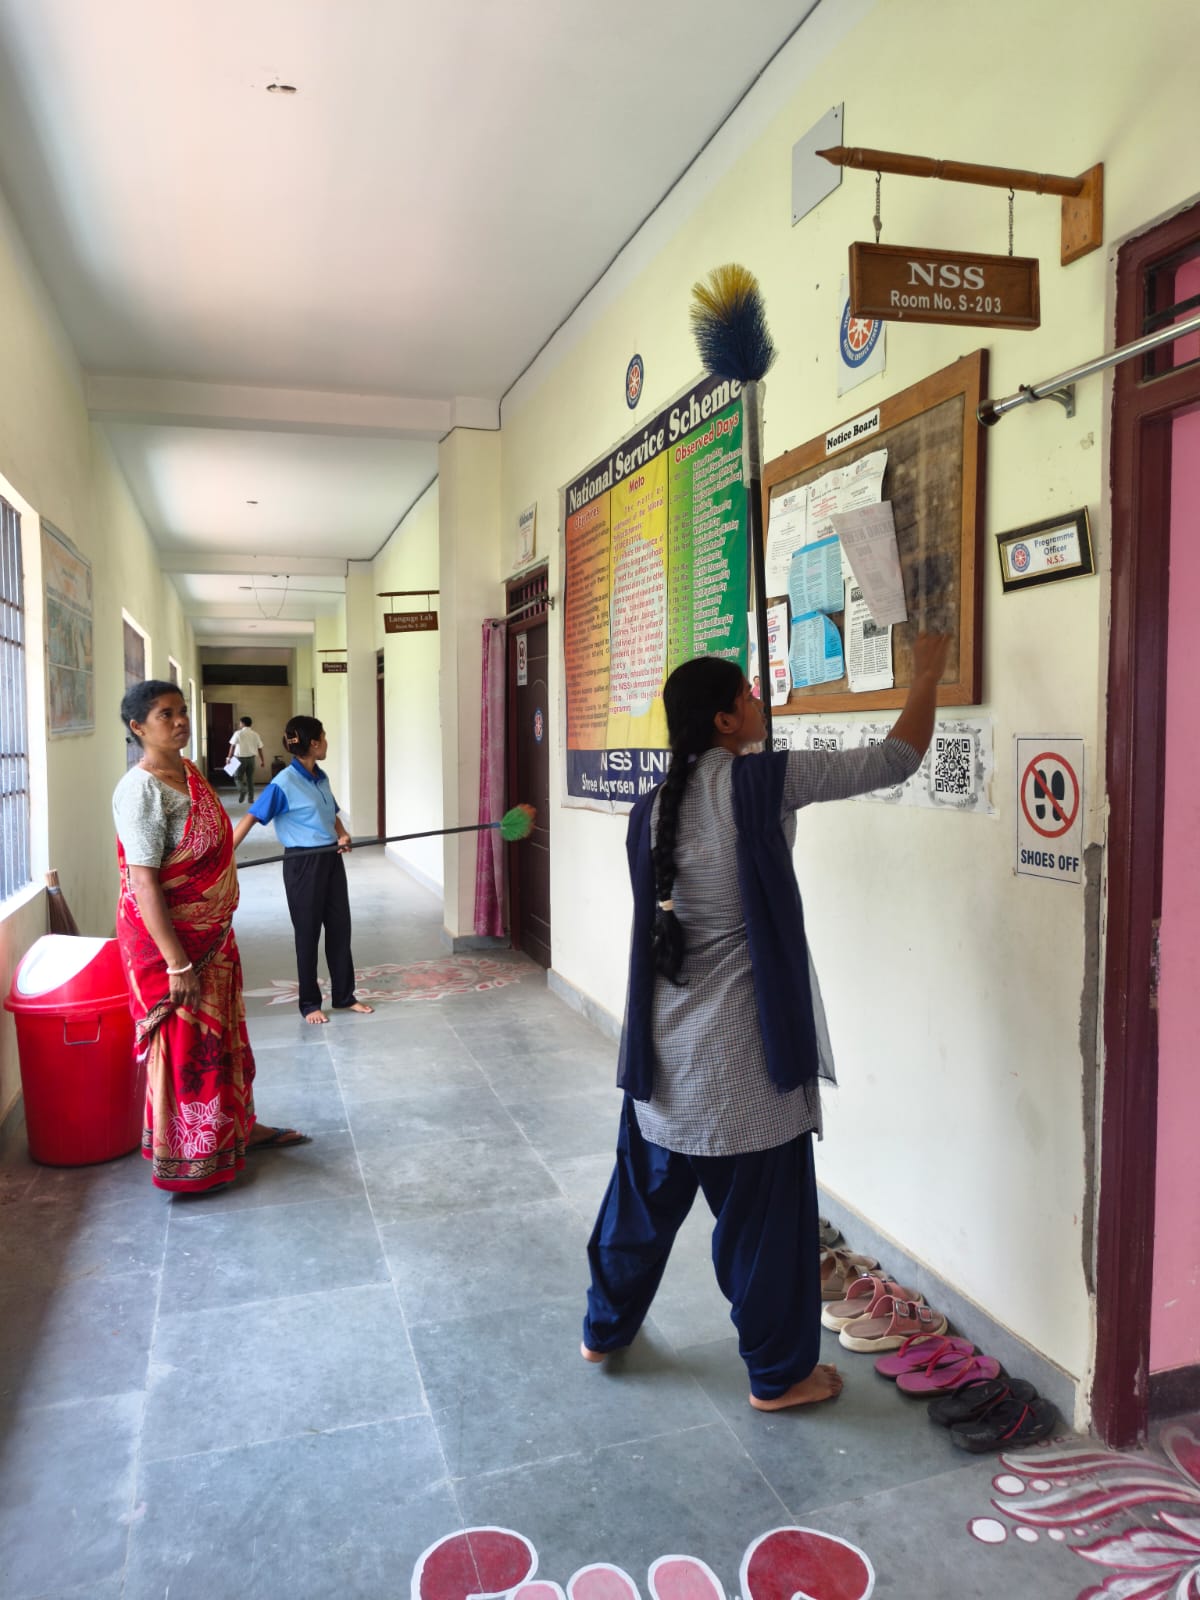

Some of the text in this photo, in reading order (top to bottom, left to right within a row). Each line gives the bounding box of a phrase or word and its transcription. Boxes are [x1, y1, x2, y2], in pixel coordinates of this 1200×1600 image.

[907, 262, 984, 290] NSS
[891, 290, 1001, 313] Room No. S-203
[675, 412, 739, 464] Observed Days
[827, 414, 878, 449] Notice Board
[569, 458, 613, 513] National
[616, 428, 664, 479] Service
[669, 378, 742, 441] Scheme
[1034, 532, 1074, 548] Programme
[1044, 545, 1066, 556] Officer
[601, 751, 671, 772] NSS UNI
[582, 773, 597, 792] Shree
[1021, 849, 1079, 872] SHOES OFF
